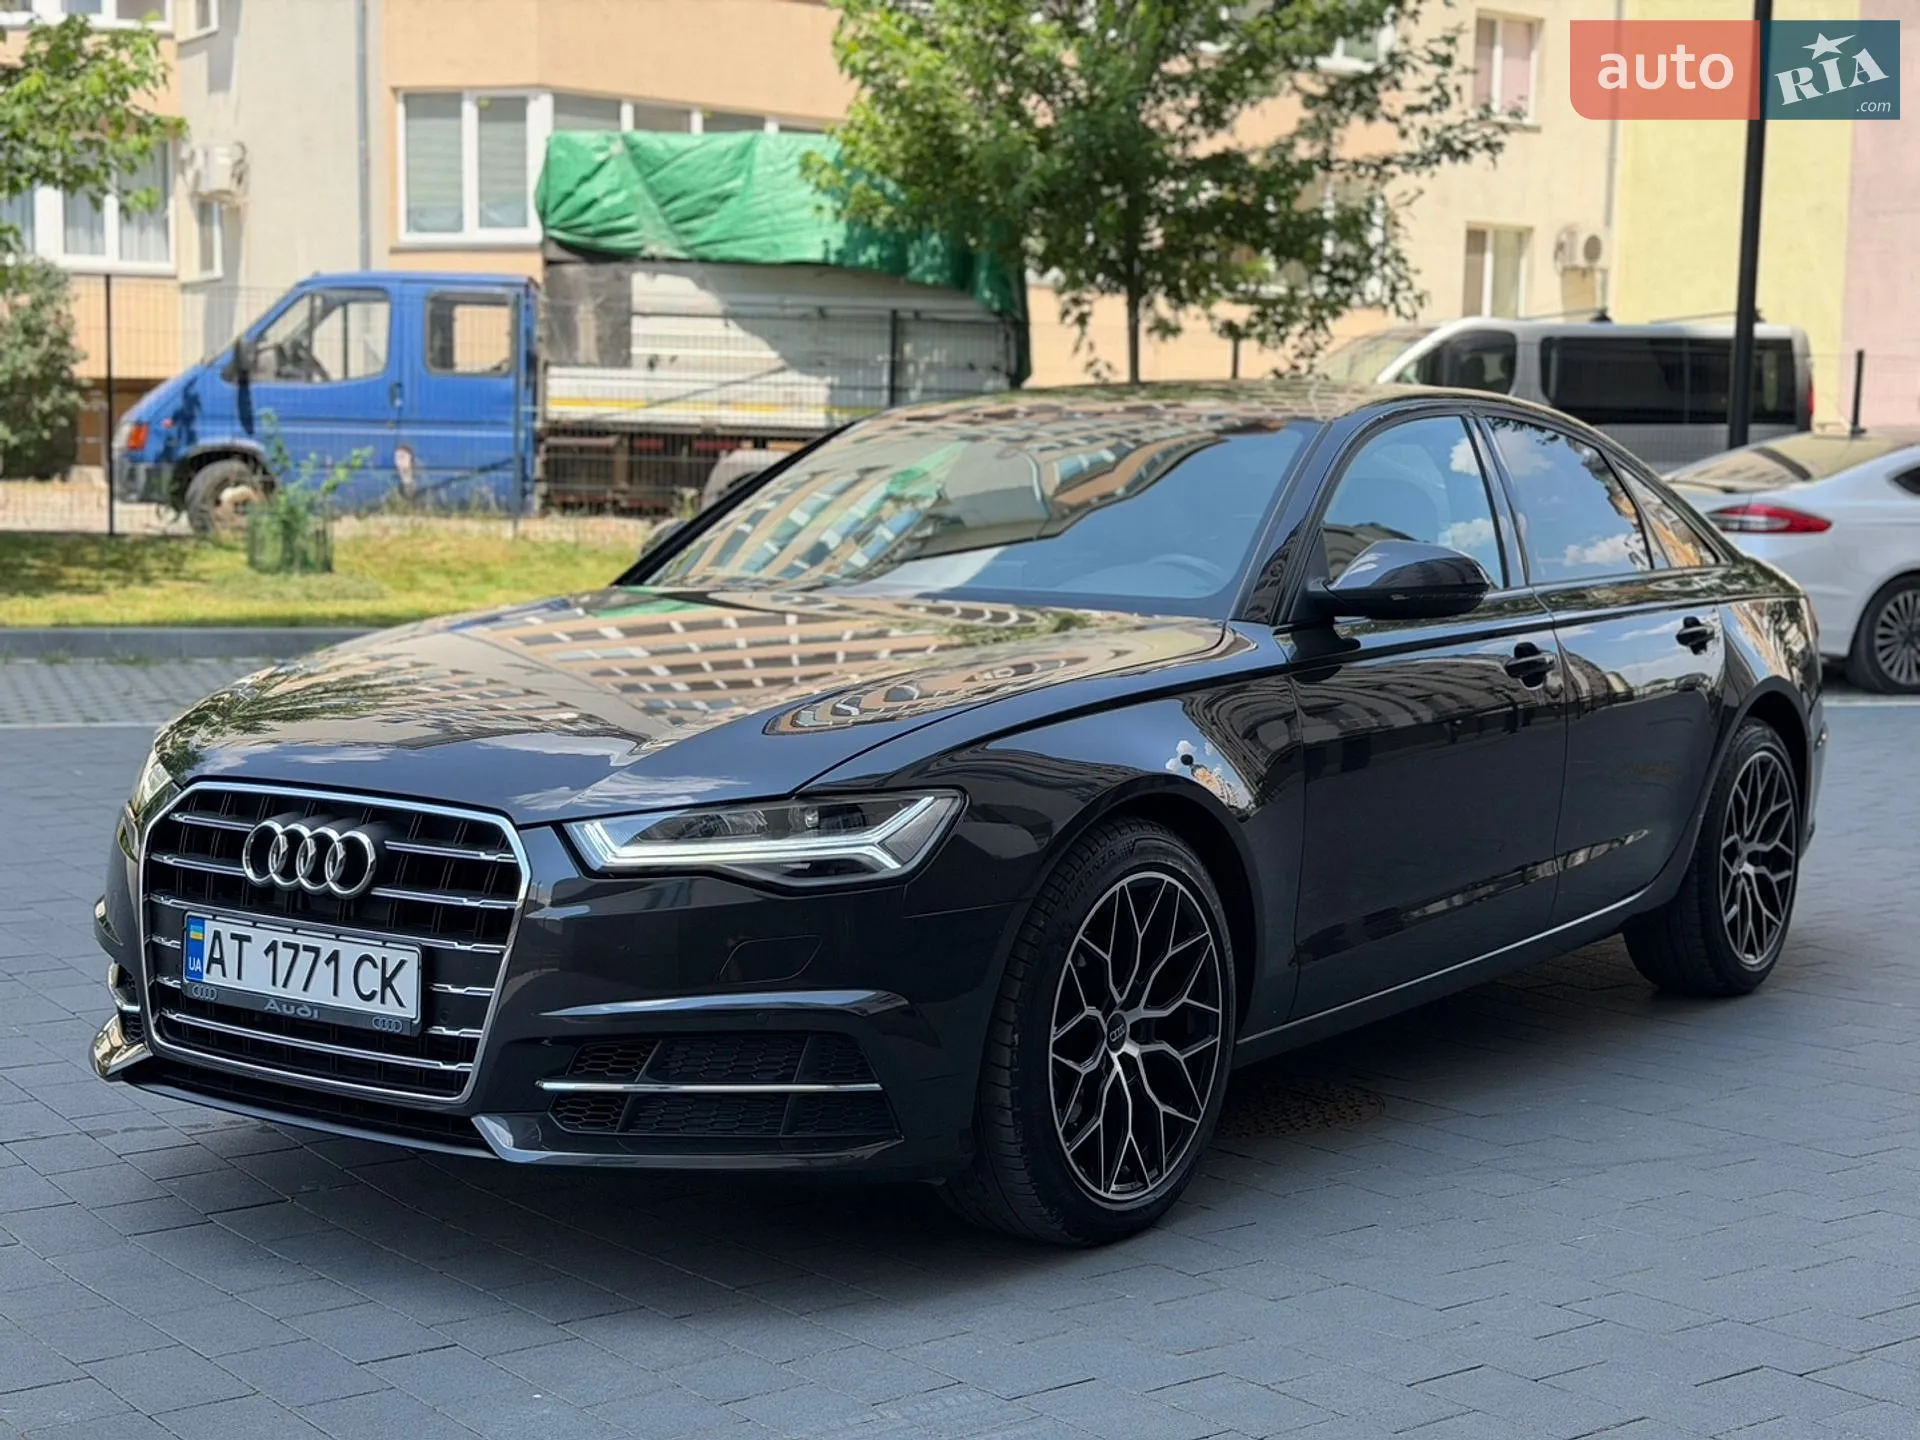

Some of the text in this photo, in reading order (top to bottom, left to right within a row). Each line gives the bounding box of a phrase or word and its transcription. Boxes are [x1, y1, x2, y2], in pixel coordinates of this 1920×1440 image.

[188, 956, 203, 973] UA
[205, 929, 409, 1009] AT 1771 CK
